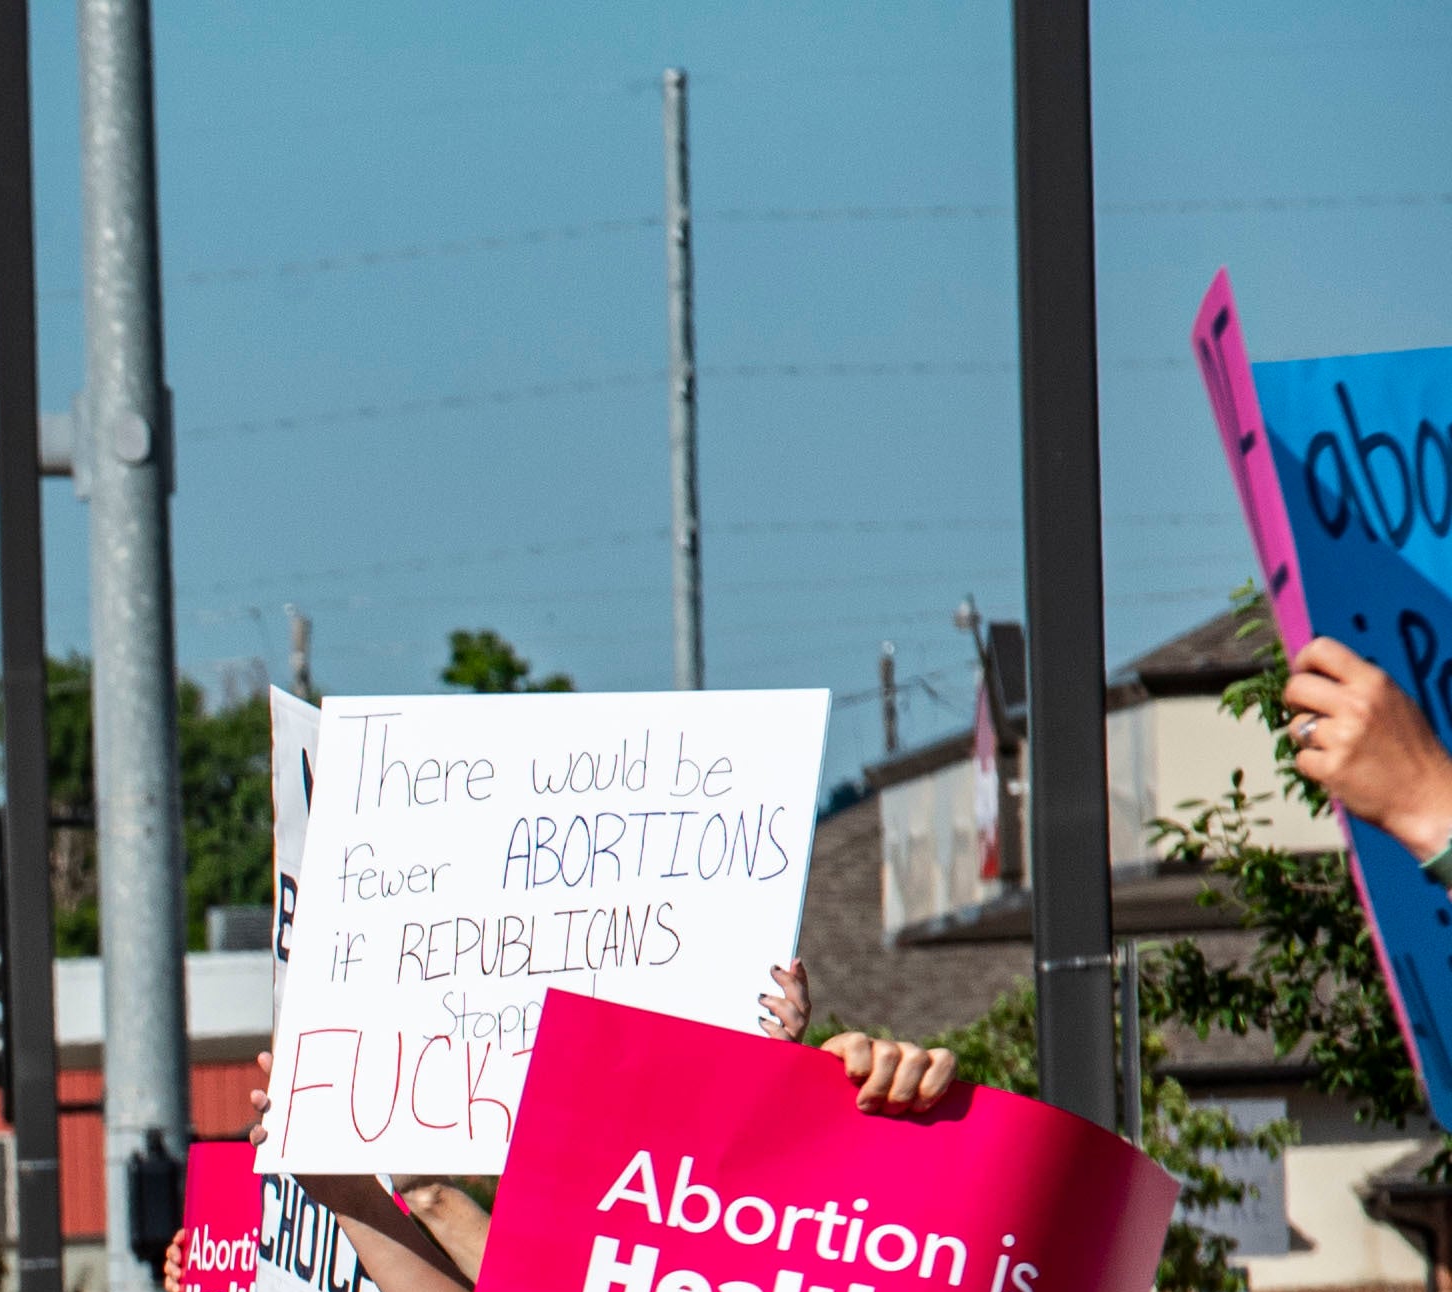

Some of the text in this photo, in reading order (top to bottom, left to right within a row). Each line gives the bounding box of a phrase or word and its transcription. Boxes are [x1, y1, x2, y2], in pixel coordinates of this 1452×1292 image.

[339, 712, 733, 814] There would be
[337, 803, 789, 902] fewer ABORTIONS
[330, 901, 681, 984] if REPUBLICANS
[282, 1029, 534, 1158] FUCK
[187, 1224, 259, 1272] Aborti
[597, 1149, 968, 1286] Abortion
